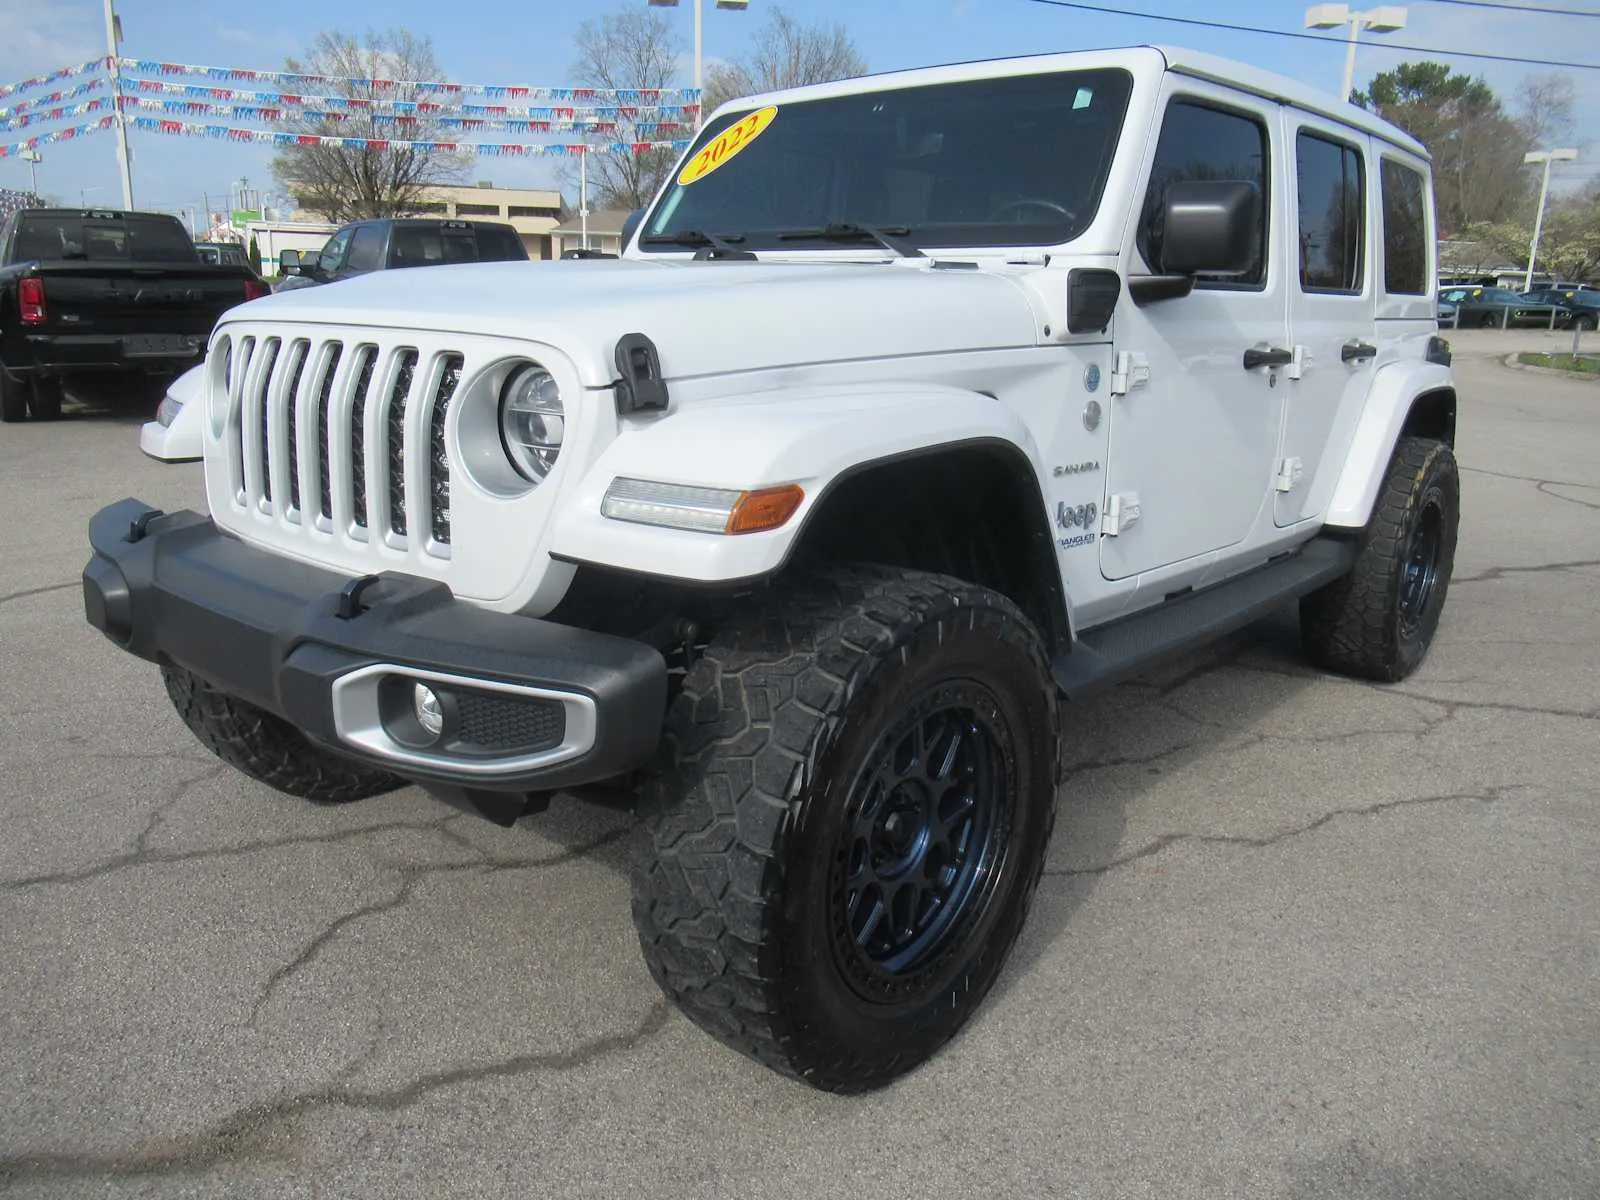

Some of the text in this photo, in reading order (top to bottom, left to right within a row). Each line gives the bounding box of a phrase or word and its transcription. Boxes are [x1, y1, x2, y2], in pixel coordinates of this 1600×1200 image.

[696, 115, 759, 176] 2022
[1053, 461, 1100, 478] SAHARA
[1056, 501, 1098, 530] Jeep
